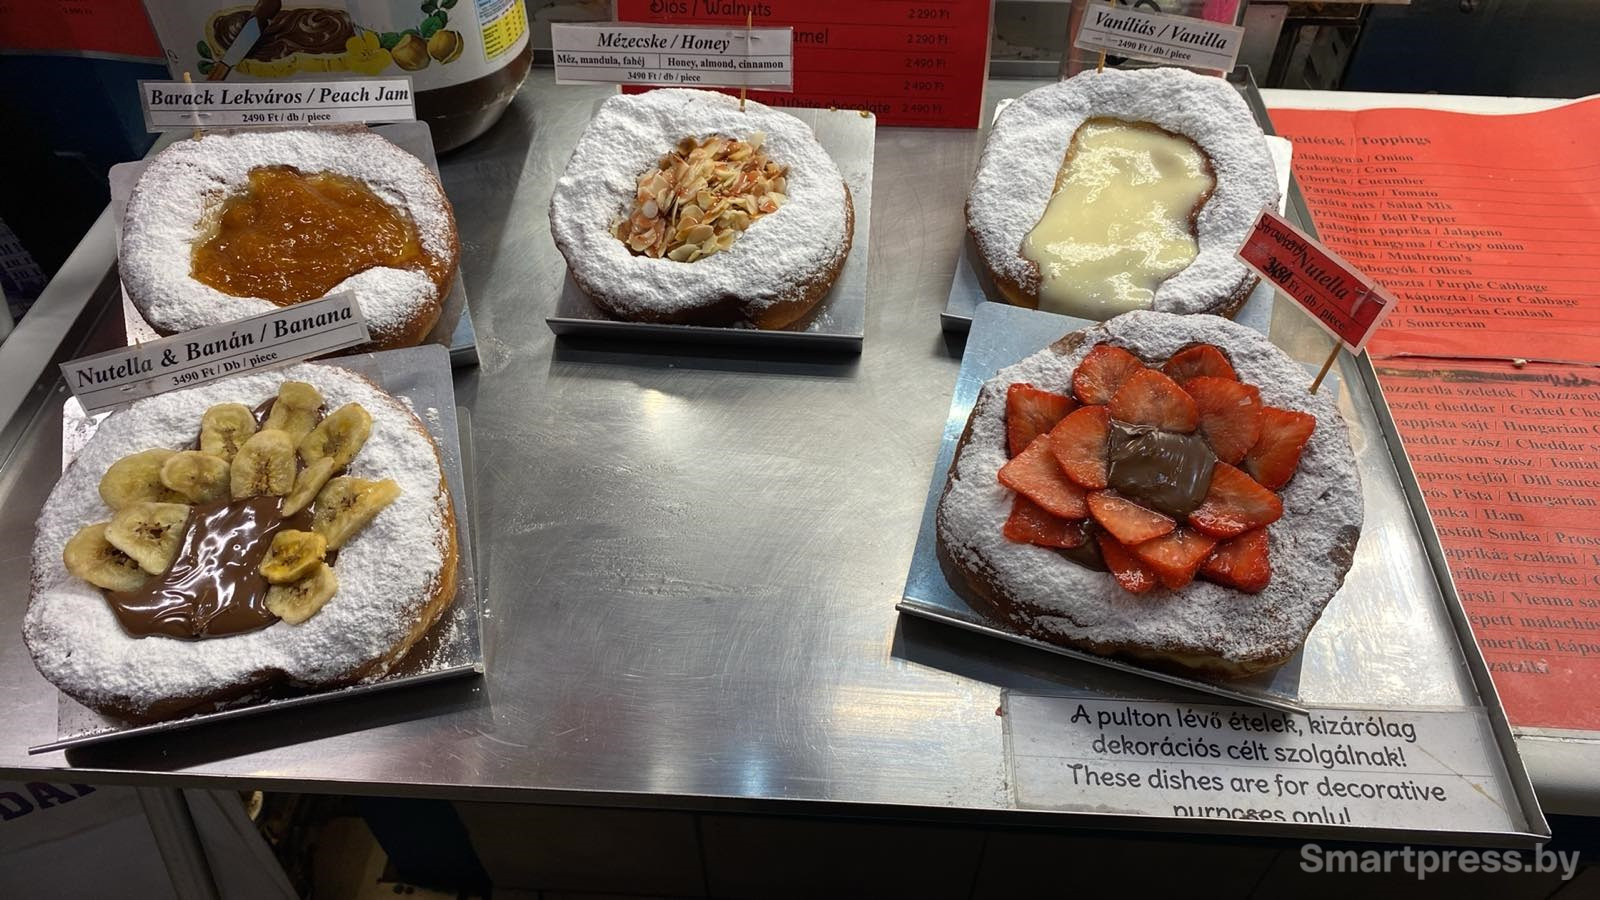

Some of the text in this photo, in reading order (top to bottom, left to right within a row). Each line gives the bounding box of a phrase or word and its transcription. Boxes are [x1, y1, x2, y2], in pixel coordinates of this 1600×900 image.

[1095, 12, 1227, 49] Vaníliás / Vanilla
[598, 32, 730, 53] Mézecske / Honey
[1117, 39, 1191, 60] 2490 Ft db piece
[557, 54, 645, 67] Méz, mandula, fahéj
[668, 57, 783, 69] Honey, almond, cinnamon
[627, 72, 701, 82] 3490 Ft db piece
[151, 86, 409, 106] Barack Lekváros / Peach Jam
[242, 112, 331, 123] 2490 Ft db piece
[1360, 135, 1431, 146] Toppings
[1374, 153, 1414, 162] Onion
[1364, 166, 1398, 174] Corn
[1357, 177, 1425, 185] Cucumber
[1304, 185, 1439, 197] Paradicsom Tomato
[1352, 200, 1376, 209] mix
[1386, 201, 1423, 210] Salad
[1426, 202, 1453, 210] Mix
[1382, 212, 1407, 222] Bell
[1410, 213, 1456, 224] Pepper
[1379, 226, 1431, 237] paprika
[1373, 238, 1524, 251] hagyma Crispy onion
[1386, 251, 1472, 263] Mushroom's
[1299, 252, 1350, 300] Nutella
[1427, 265, 1473, 276] Olives
[1436, 279, 1549, 293] Purple Cabbage
[1478, 293, 1512, 304] Sour
[1515, 295, 1579, 307] Cabbage
[1303, 293, 1317, 307] db
[1319, 308, 1345, 331] piece
[1413, 305, 1490, 317] Hungarian
[1494, 306, 1554, 318] Goulash
[1407, 318, 1486, 329] Sourcream
[76, 305, 352, 388] Nutella & Banán / Banana
[172, 351, 278, 387] 3490 Ft Db piece
[1382, 384, 1452, 396] ozzarella
[1457, 385, 1516, 398] szeletek
[1434, 402, 1495, 413] cheddar
[1510, 404, 1565, 417] Grated
[1395, 418, 1589, 435] appista sajt Hungarian
[1462, 435, 1501, 447] szósz
[1516, 437, 1585, 451] Cheddar
[1494, 454, 1534, 467] szósz
[1550, 457, 1600, 470] Tomat
[1522, 474, 1552, 486] Dill
[1556, 477, 1600, 488] sauce
[1453, 488, 1493, 501] Pista
[1507, 491, 1597, 507] Hungarian
[1483, 508, 1525, 522] Ham
[1487, 528, 1540, 542] Sonka
[1527, 571, 1579, 586] csirke
[1510, 591, 1574, 605] Vienna
[1070, 704, 1416, 743] A pulton lévő ételek, kizárólag
[1092, 733, 1407, 769] dekorációs célt szolgálnak!
[1066, 763, 1447, 802] These dishes are for decorative
[0, 782, 97, 821] DA
